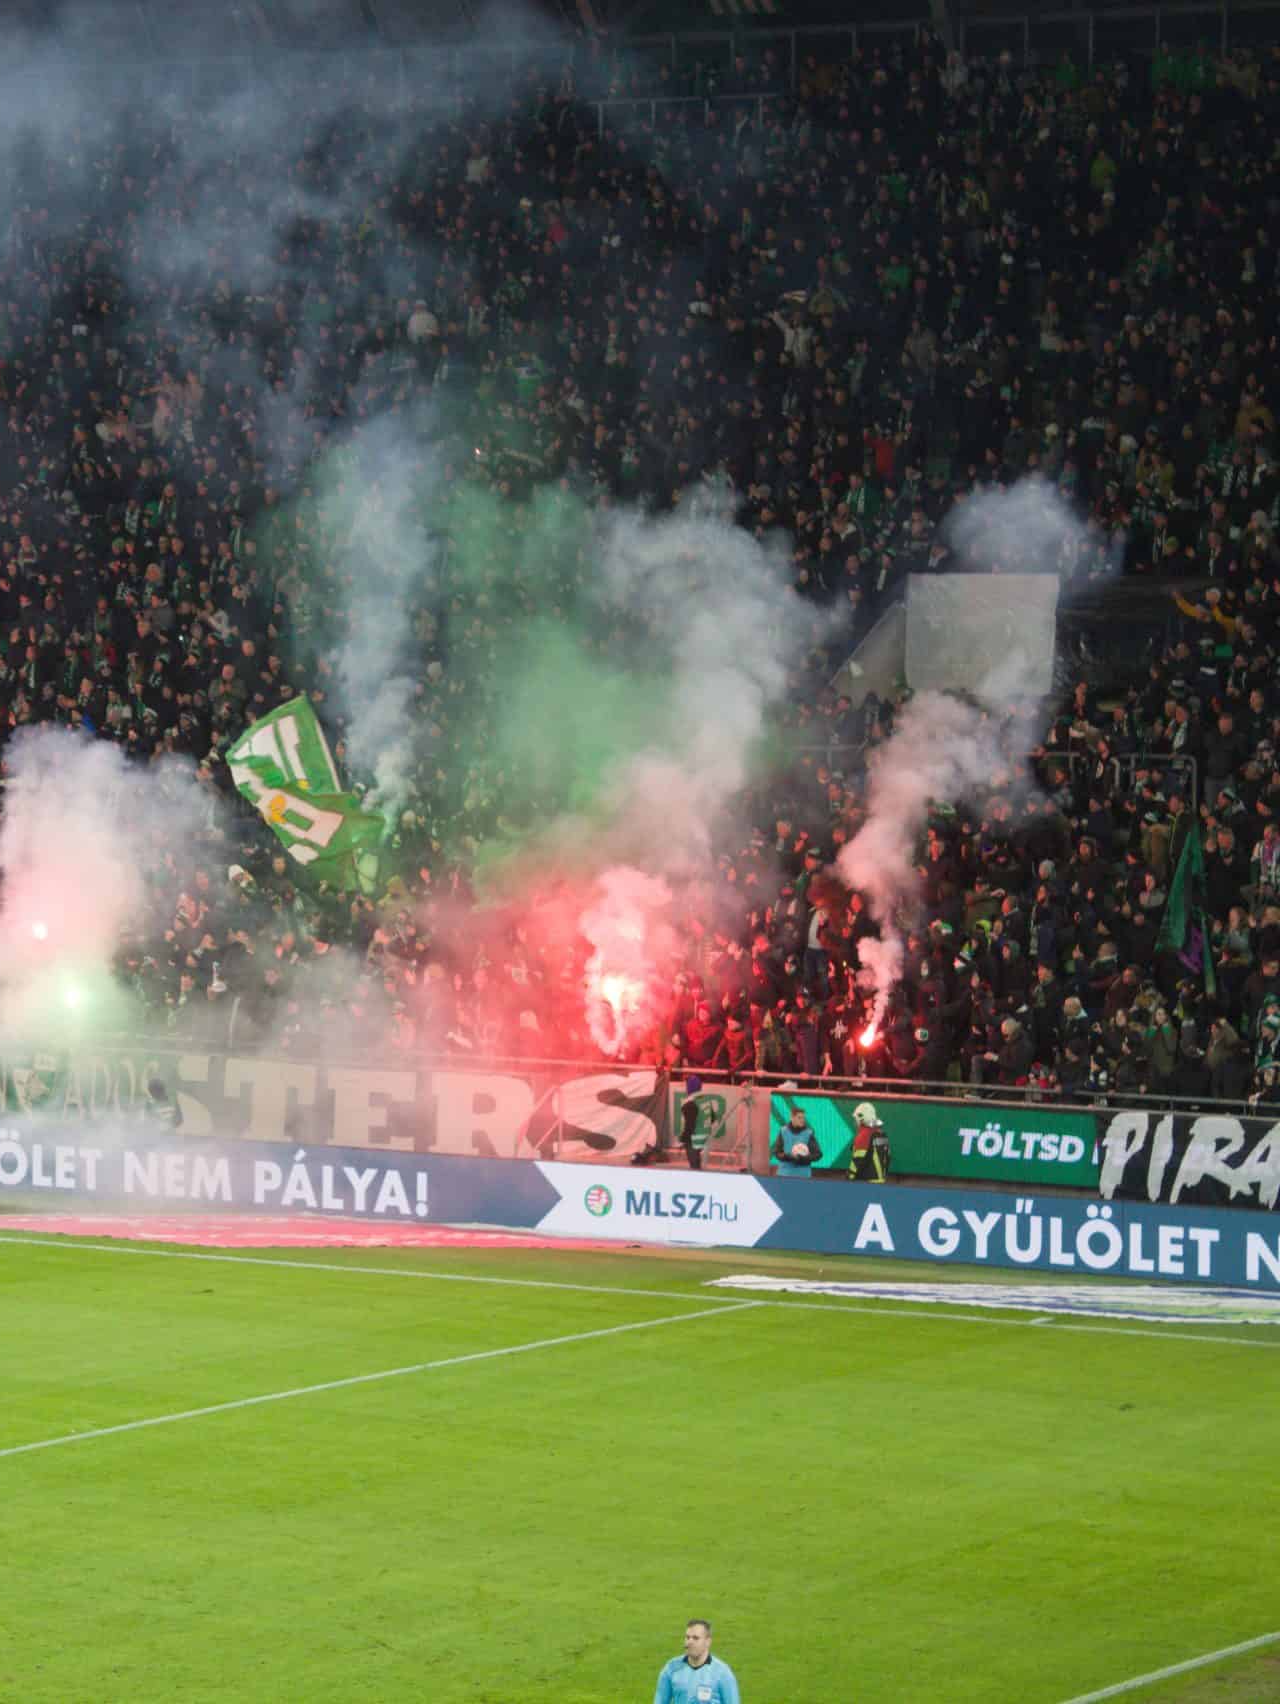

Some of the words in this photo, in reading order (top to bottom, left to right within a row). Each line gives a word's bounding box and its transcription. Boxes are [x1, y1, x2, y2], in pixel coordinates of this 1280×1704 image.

[959, 1122, 1084, 1165] TÖLTSD
[124, 1150, 233, 1202] NEM
[254, 1150, 429, 1217] PÁLYA!
[625, 1188, 738, 1223] MLSZ.hu
[854, 1202, 895, 1251] A
